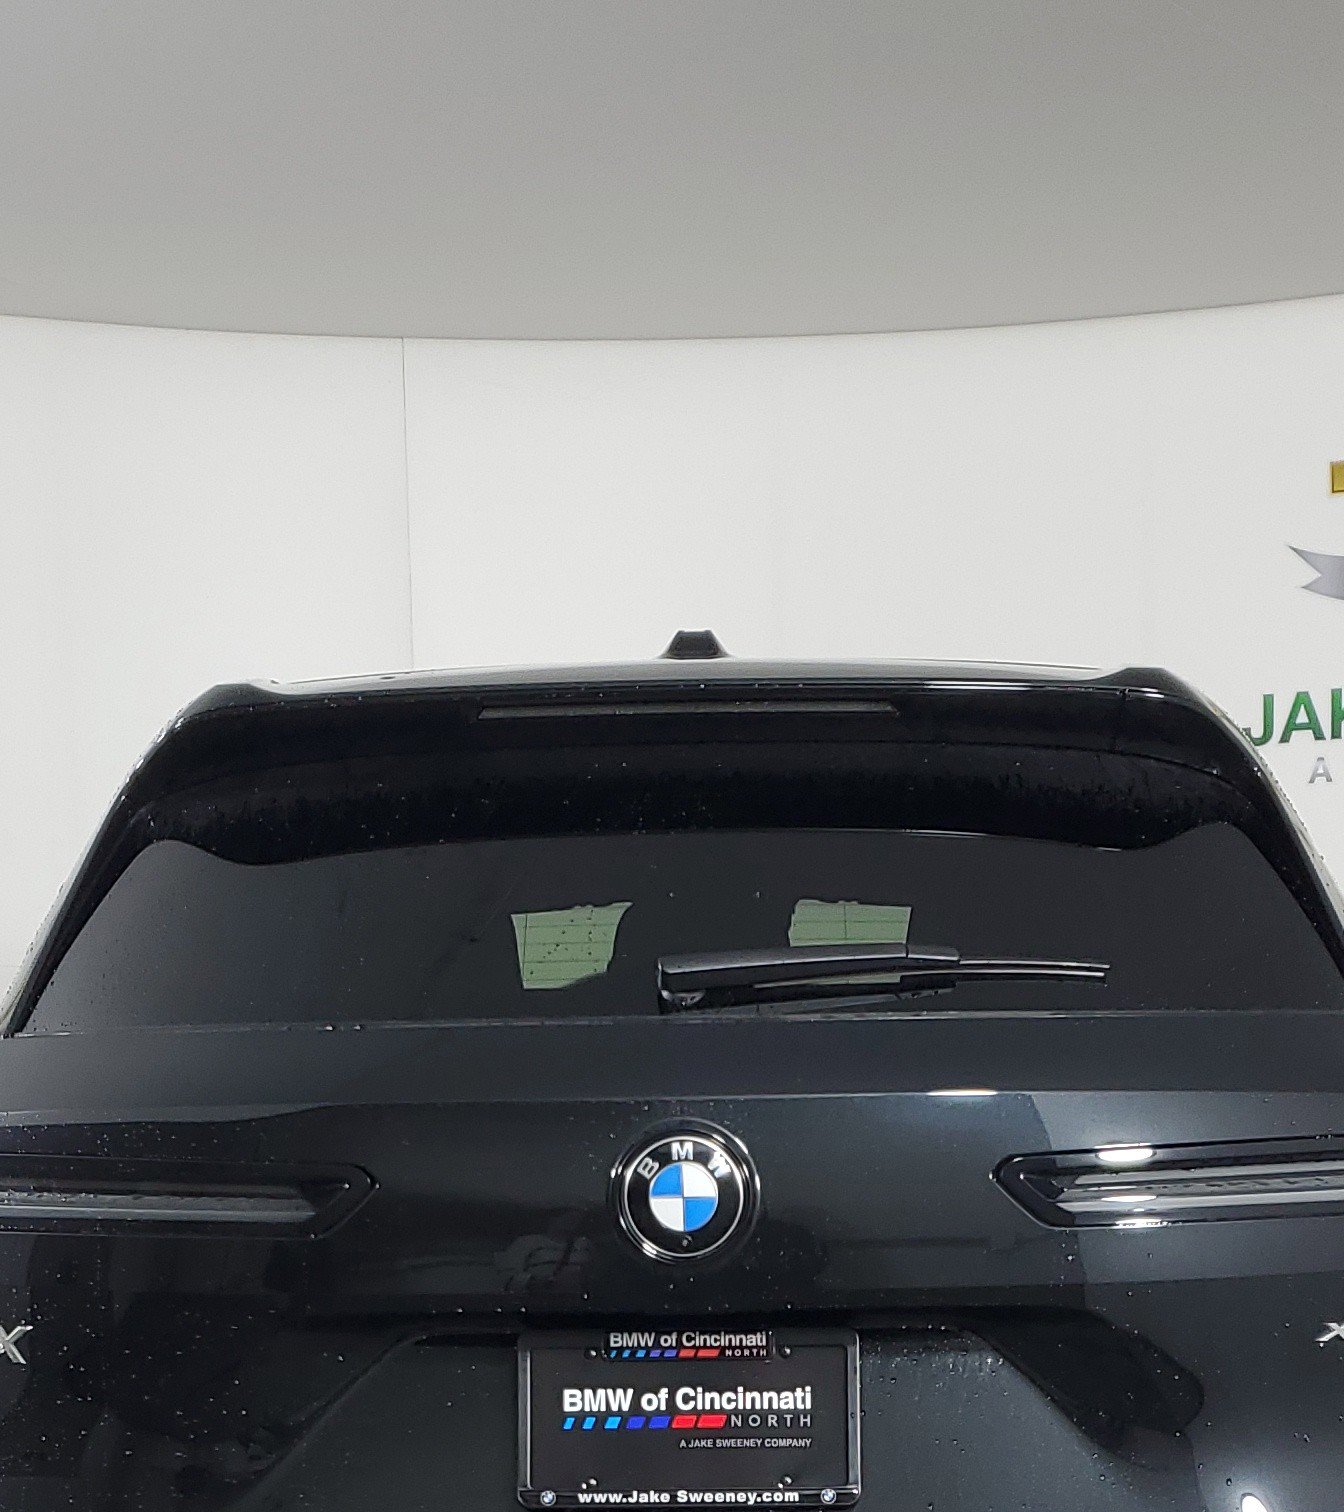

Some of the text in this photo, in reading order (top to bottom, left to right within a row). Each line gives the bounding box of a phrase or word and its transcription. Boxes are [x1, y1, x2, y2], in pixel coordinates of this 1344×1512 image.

[637, 1141, 732, 1180] BMW
[609, 1331, 767, 1348] BMW of Cincinnati
[725, 1349, 767, 1357] NORTH
[563, 1386, 812, 1412] BMW of Cincinnati
[731, 1414, 812, 1428] NORTH
[679, 1438, 812, 1448] A JAKE SWEENEY COMPANY
[577, 1490, 800, 1505] www.Jake Sweeney.com
